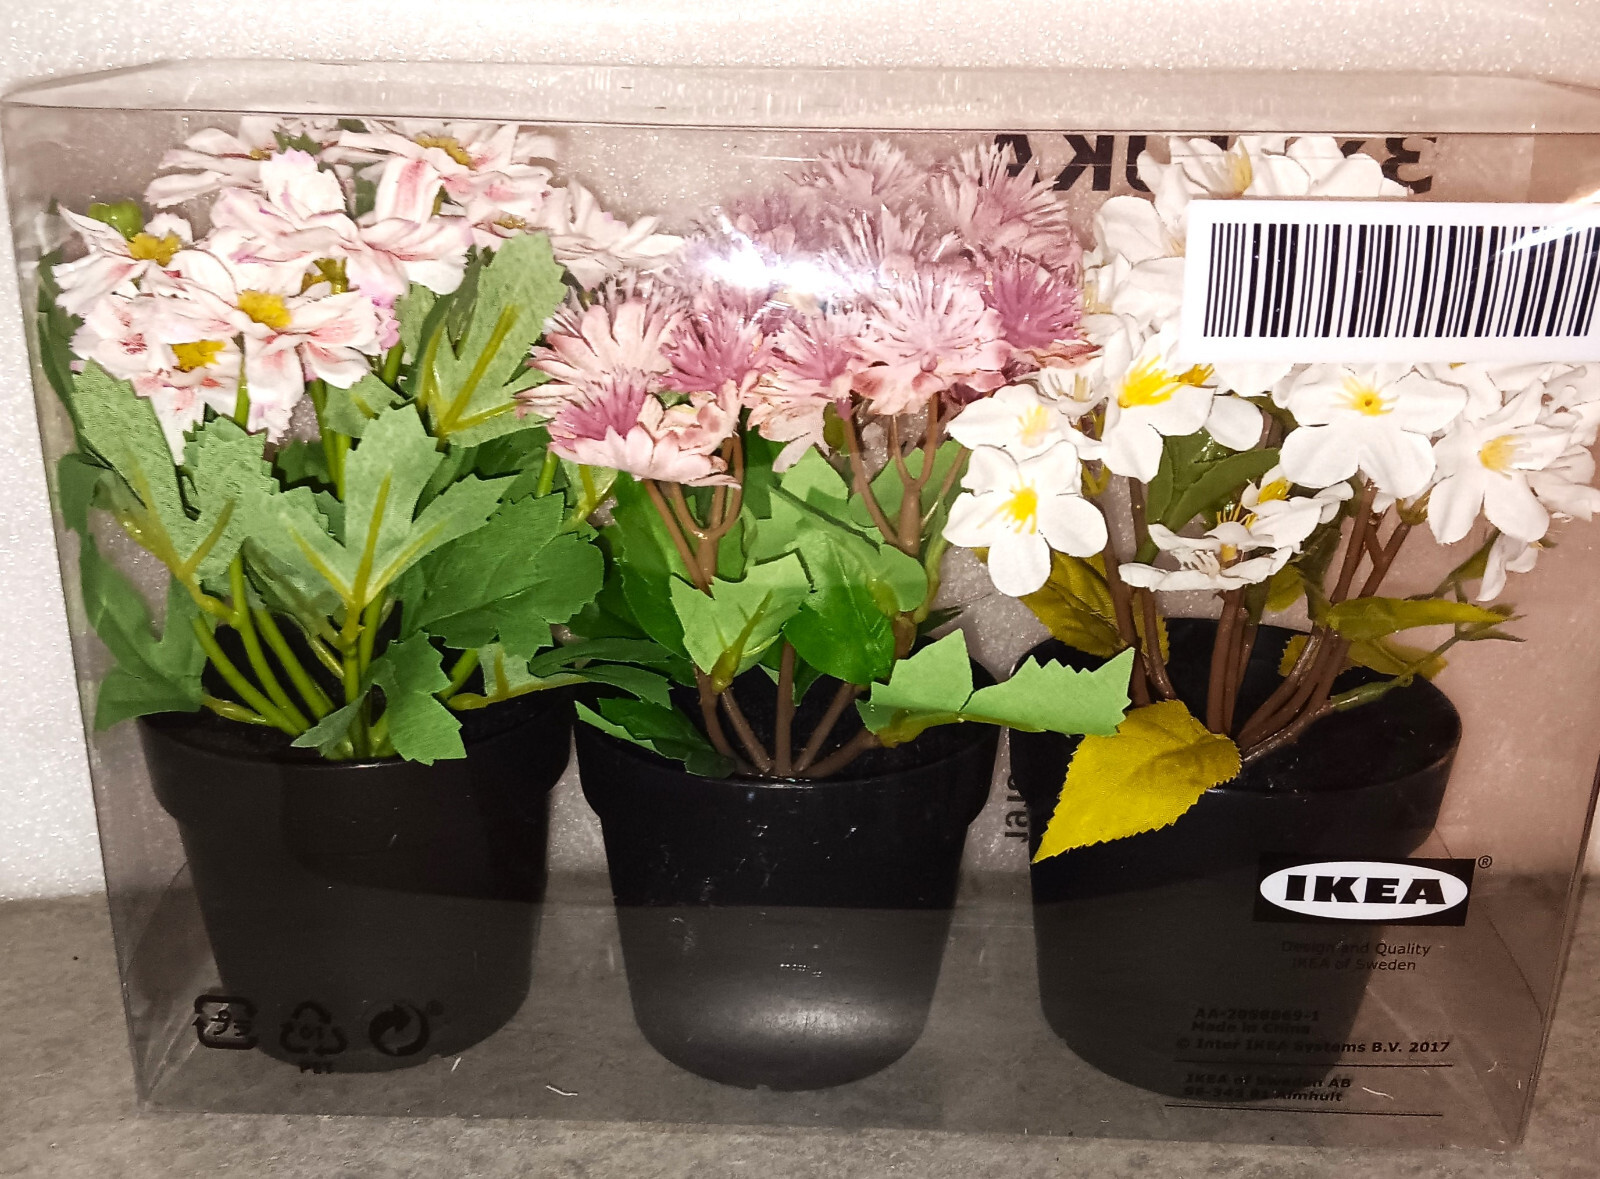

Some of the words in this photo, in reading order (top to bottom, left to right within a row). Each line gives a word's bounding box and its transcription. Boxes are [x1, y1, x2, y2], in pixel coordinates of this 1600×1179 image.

[1284, 874, 1447, 905] IKEA
[1281, 941, 1335, 956] Design
[1341, 941, 1369, 954] and
[1375, 942, 1432, 957] Quality
[1292, 958, 1331, 970] IKEA
[1334, 958, 1349, 970] of
[1355, 959, 1417, 971] Sweden
[1191, 1021, 1238, 1033] Made
[1262, 1022, 1311, 1035] China
[1196, 1037, 1240, 1050] Inter
[1246, 1038, 1289, 1051] IKEA
[1293, 1039, 1366, 1054] Systems
[1371, 1041, 1402, 1053] B.V.
[1409, 1041, 1450, 1053] 2017
[1185, 1073, 1227, 1084] IKEA
[1256, 1075, 1323, 1088] Sweden
[1327, 1077, 1352, 1088] AB
